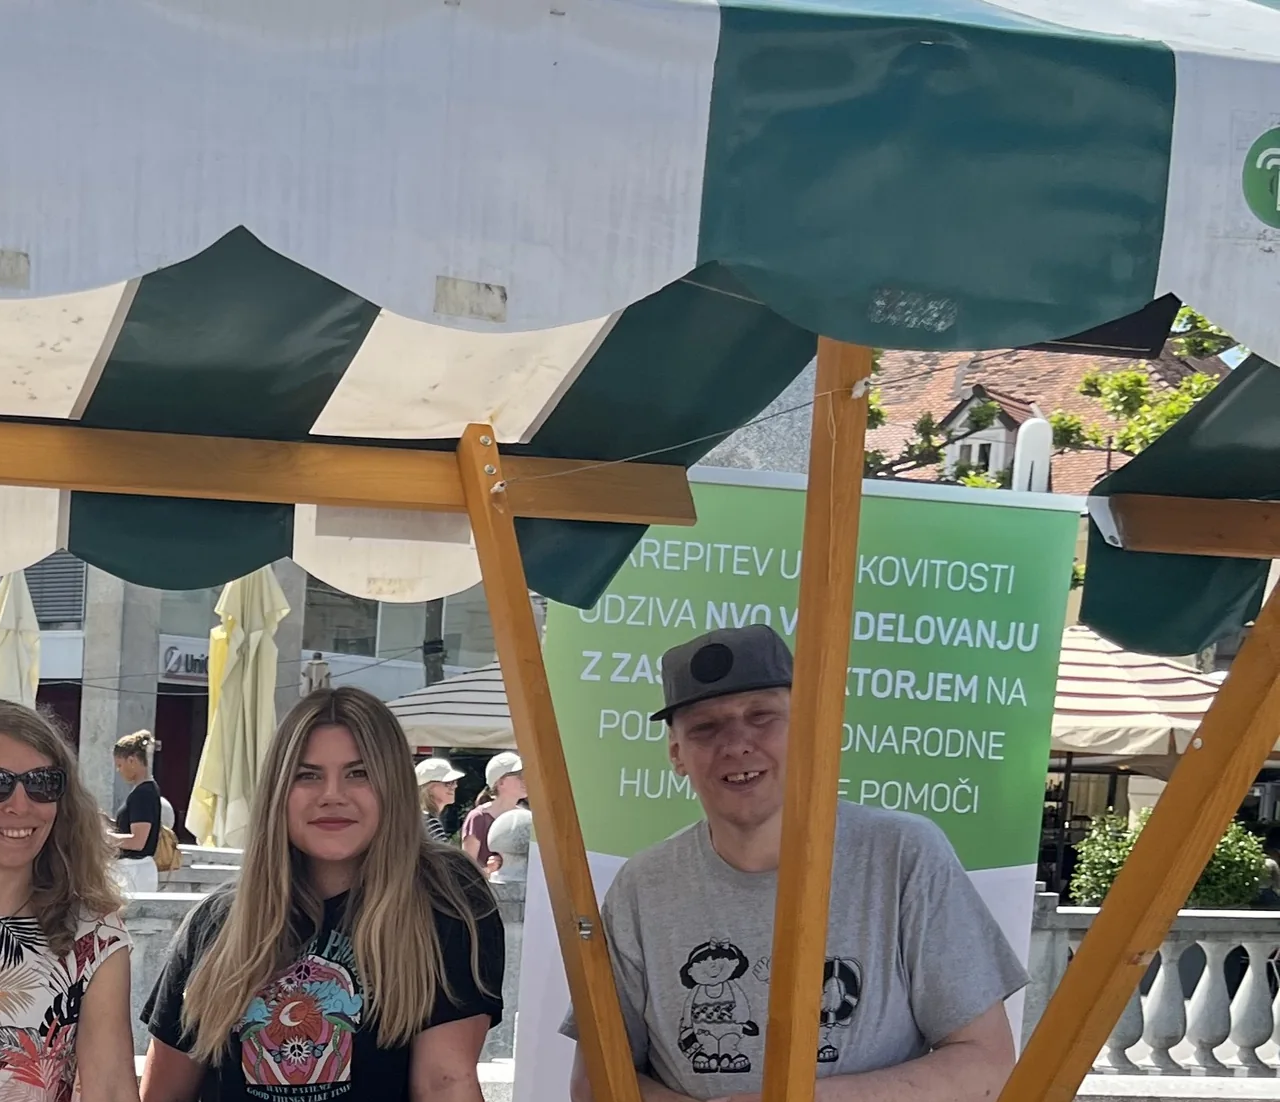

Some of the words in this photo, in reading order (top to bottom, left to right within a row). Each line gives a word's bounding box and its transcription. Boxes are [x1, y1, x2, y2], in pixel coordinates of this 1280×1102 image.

[706, 600, 771, 630] NVO
[853, 611, 1039, 652] DELOVANJU
[580, 650, 602, 681] Z
[986, 676, 1027, 707] NA
[860, 777, 979, 813] POMOČI
[247, 1087, 269, 1100] GOOD
